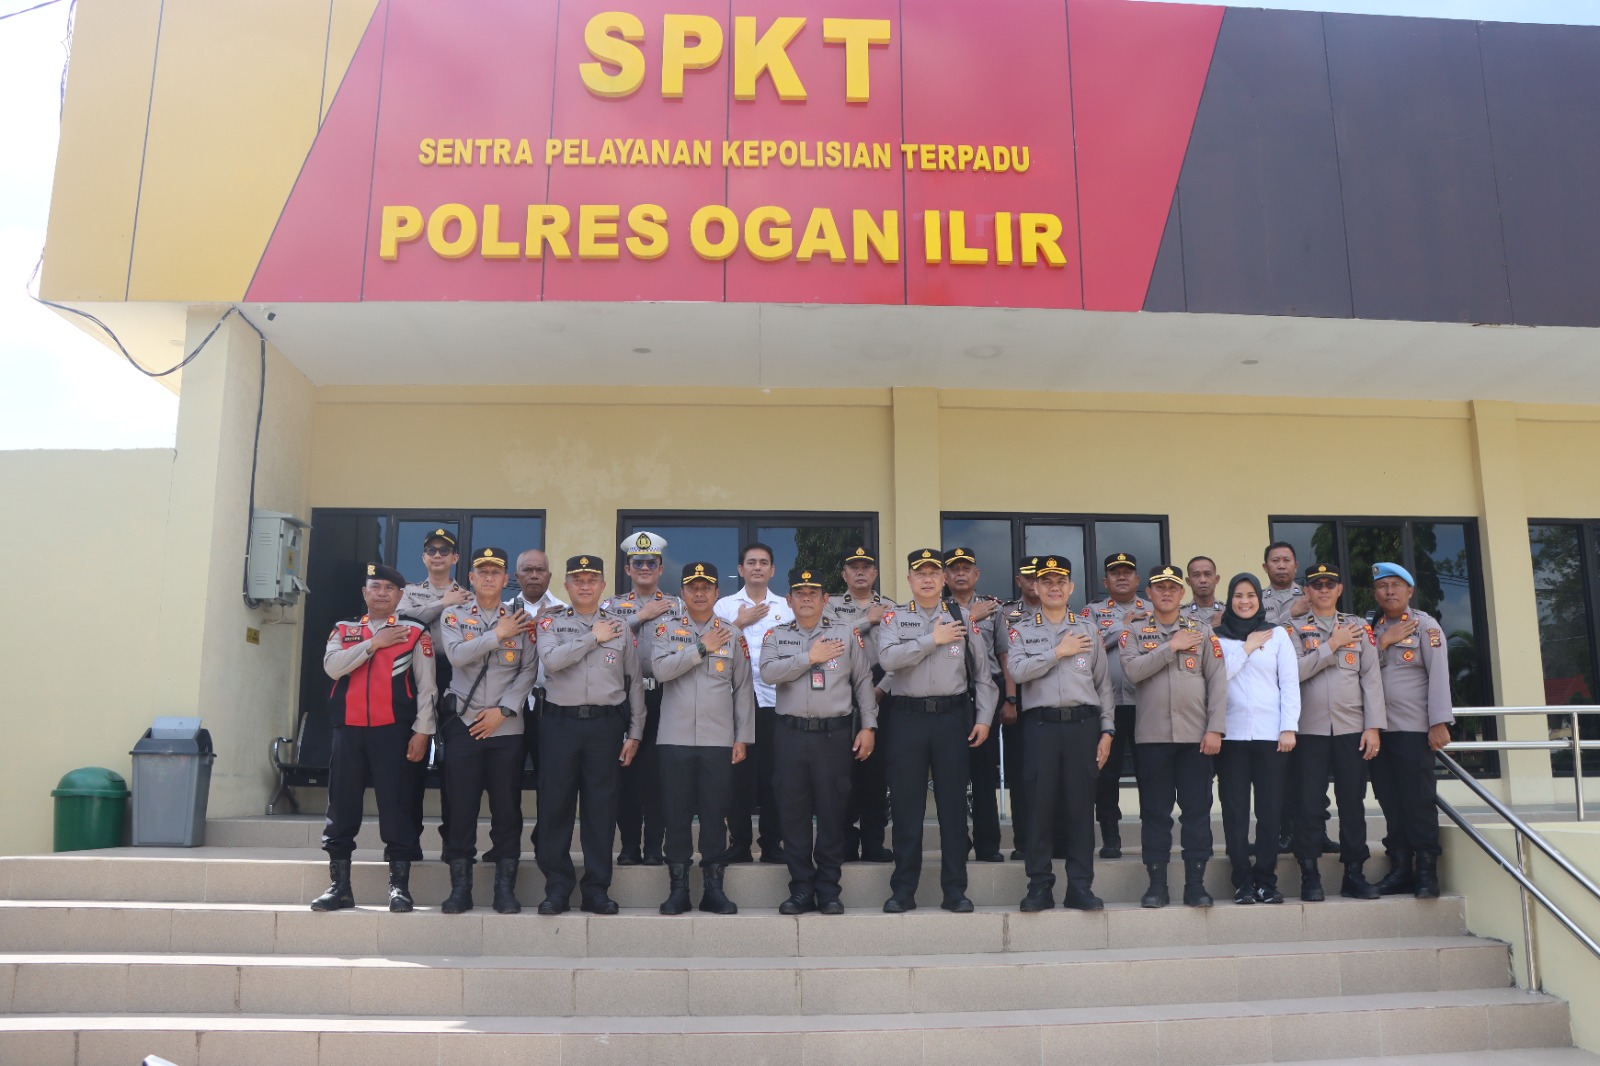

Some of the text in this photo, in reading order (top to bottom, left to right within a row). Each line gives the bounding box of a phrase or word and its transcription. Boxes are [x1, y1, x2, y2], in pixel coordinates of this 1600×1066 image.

[580, 12, 890, 101] SPKT
[419, 138, 1029, 171] SENTRA PELAYANAN KEPOLISIAN TERPADU
[380, 204, 1066, 266] POLRES OGAN ILIR
